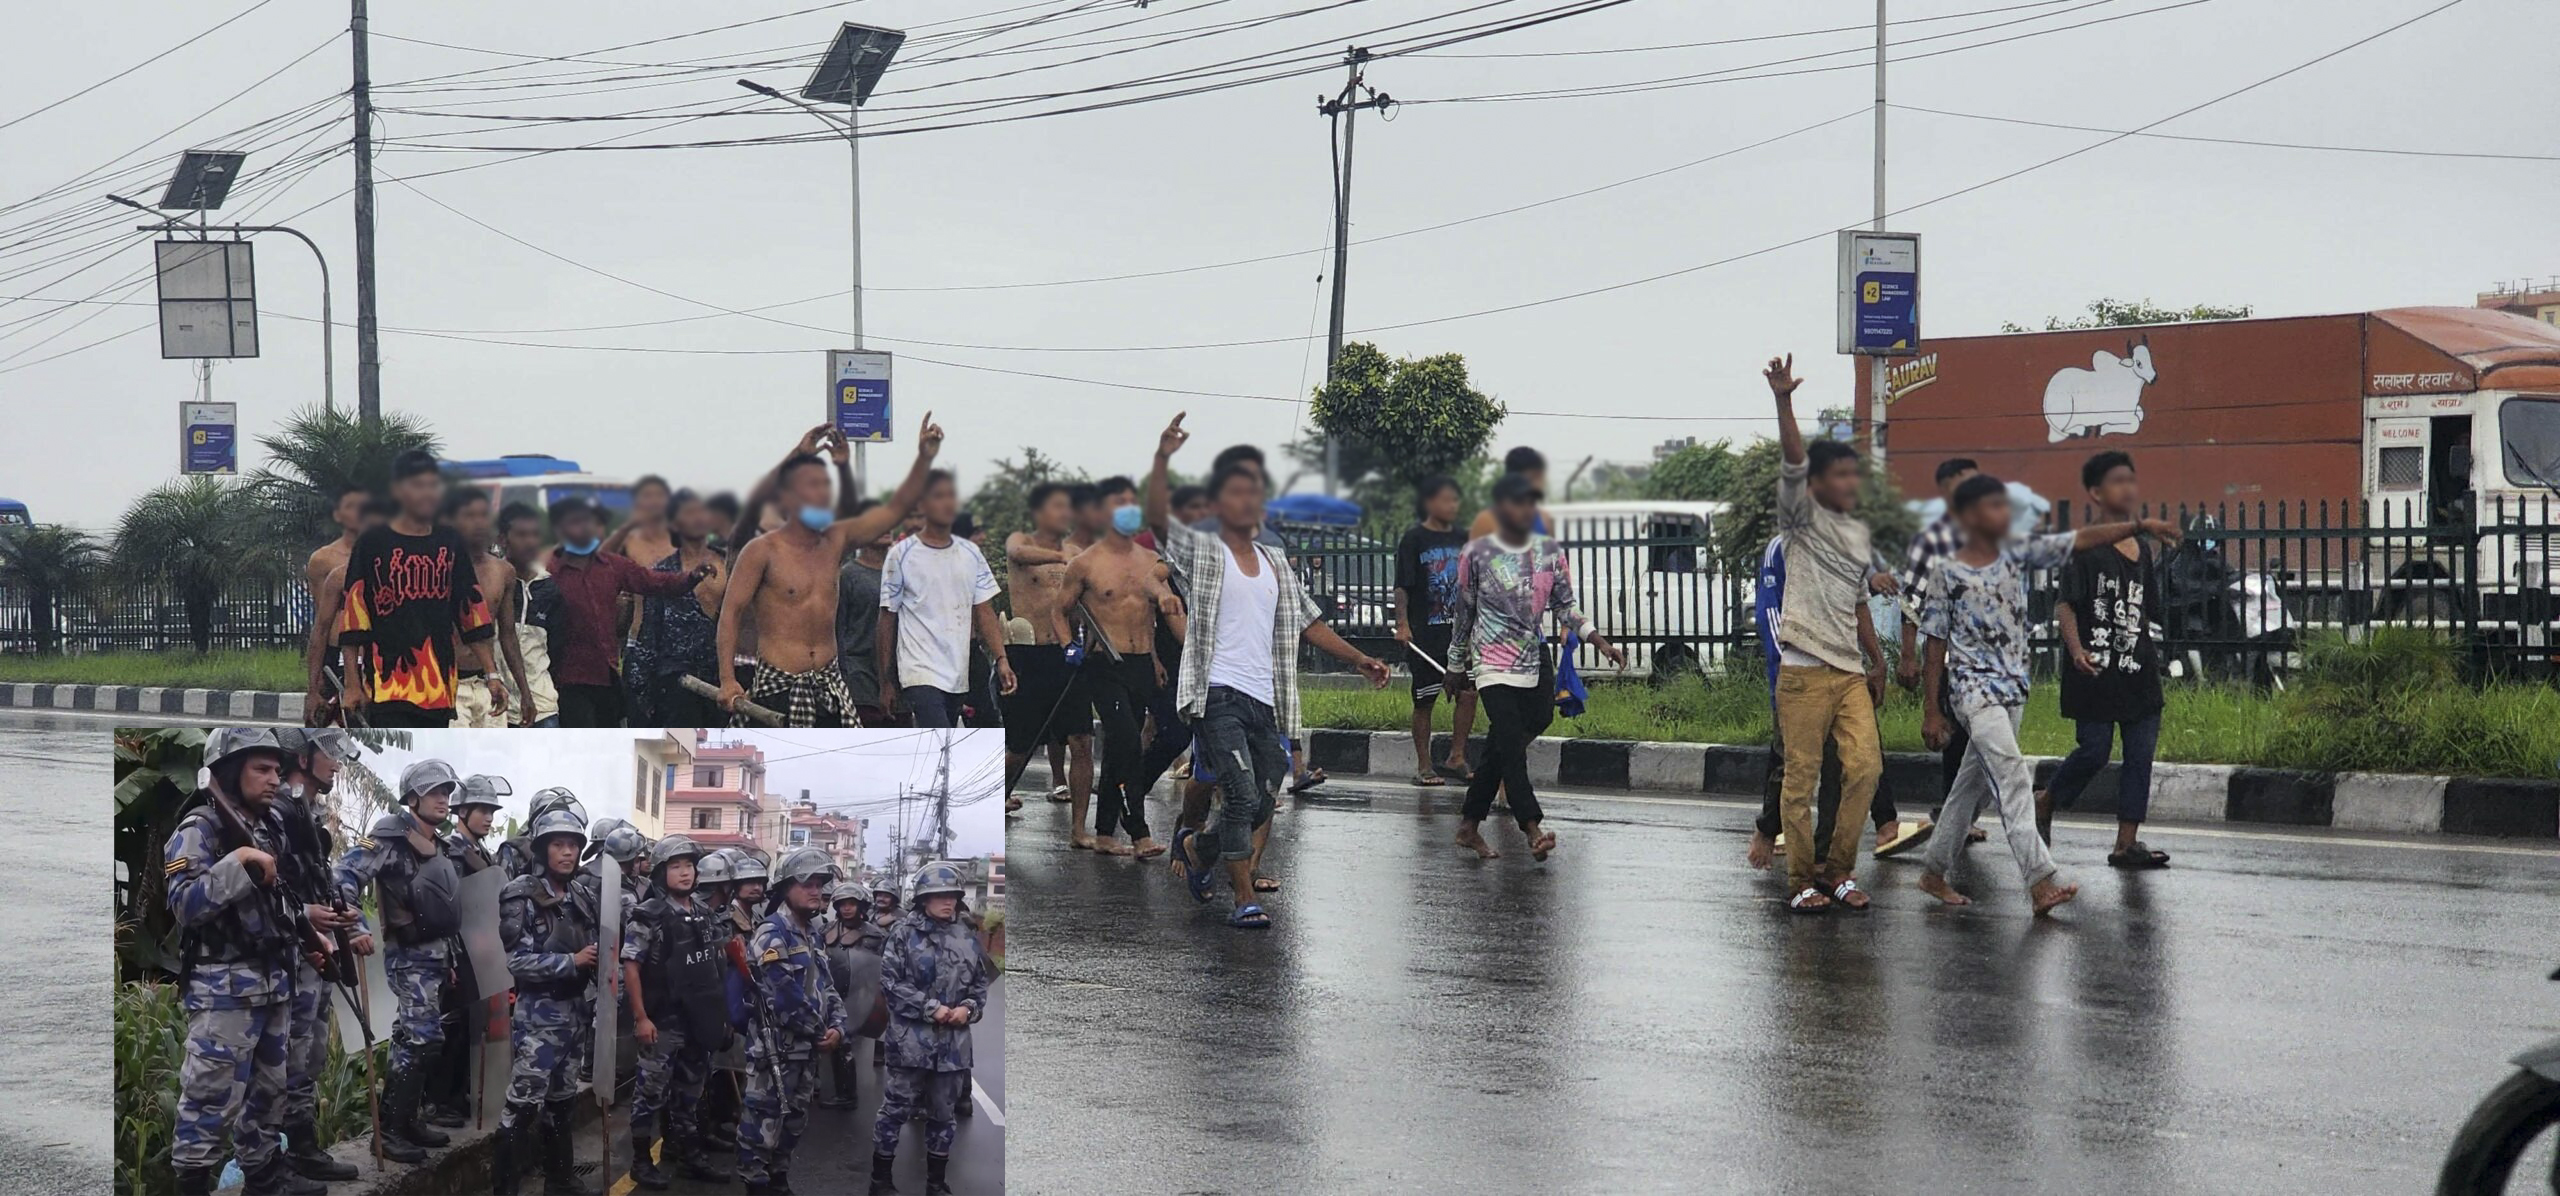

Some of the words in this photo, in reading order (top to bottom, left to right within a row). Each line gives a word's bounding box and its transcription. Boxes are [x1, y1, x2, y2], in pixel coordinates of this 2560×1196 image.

[1866, 287, 1878, 298] +2
[1884, 352, 1938, 405] SAURAV
[845, 391, 855, 400] +2
[2382, 429, 2421, 439] WELCOME
